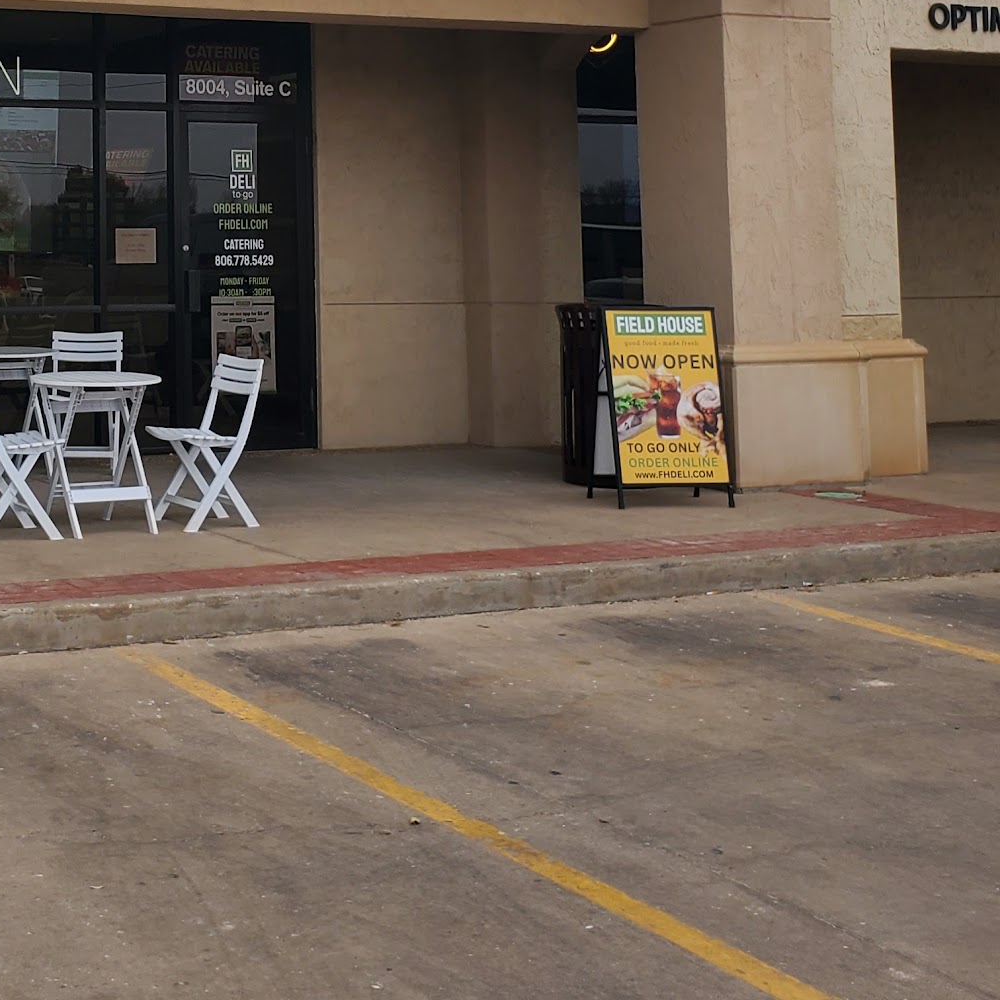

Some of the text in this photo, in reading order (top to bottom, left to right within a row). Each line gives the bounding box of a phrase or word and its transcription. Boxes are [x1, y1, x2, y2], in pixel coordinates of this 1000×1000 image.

[185, 45, 260, 60] CATERING
[186, 79, 292, 98] 8004, Suite C
[235, 153, 250, 168] FH
[229, 174, 256, 190] DELI
[213, 203, 273, 214] ORDER ONLINE
[218, 219, 268, 231] FHDELI.COM
[223, 238, 264, 250] CATERING
[214, 255, 274, 267] 806.778.5429
[220, 276, 269, 285] MONDAY FRIDAY
[616, 316, 704, 334] FIELD HOUSE
[612, 354, 715, 370] NOW OPEN
[627, 442, 701, 454] TO GO ONLY
[628, 457, 718, 468] ORDER ONLINE
[635, 470, 714, 479] www.FHDELI.COM
